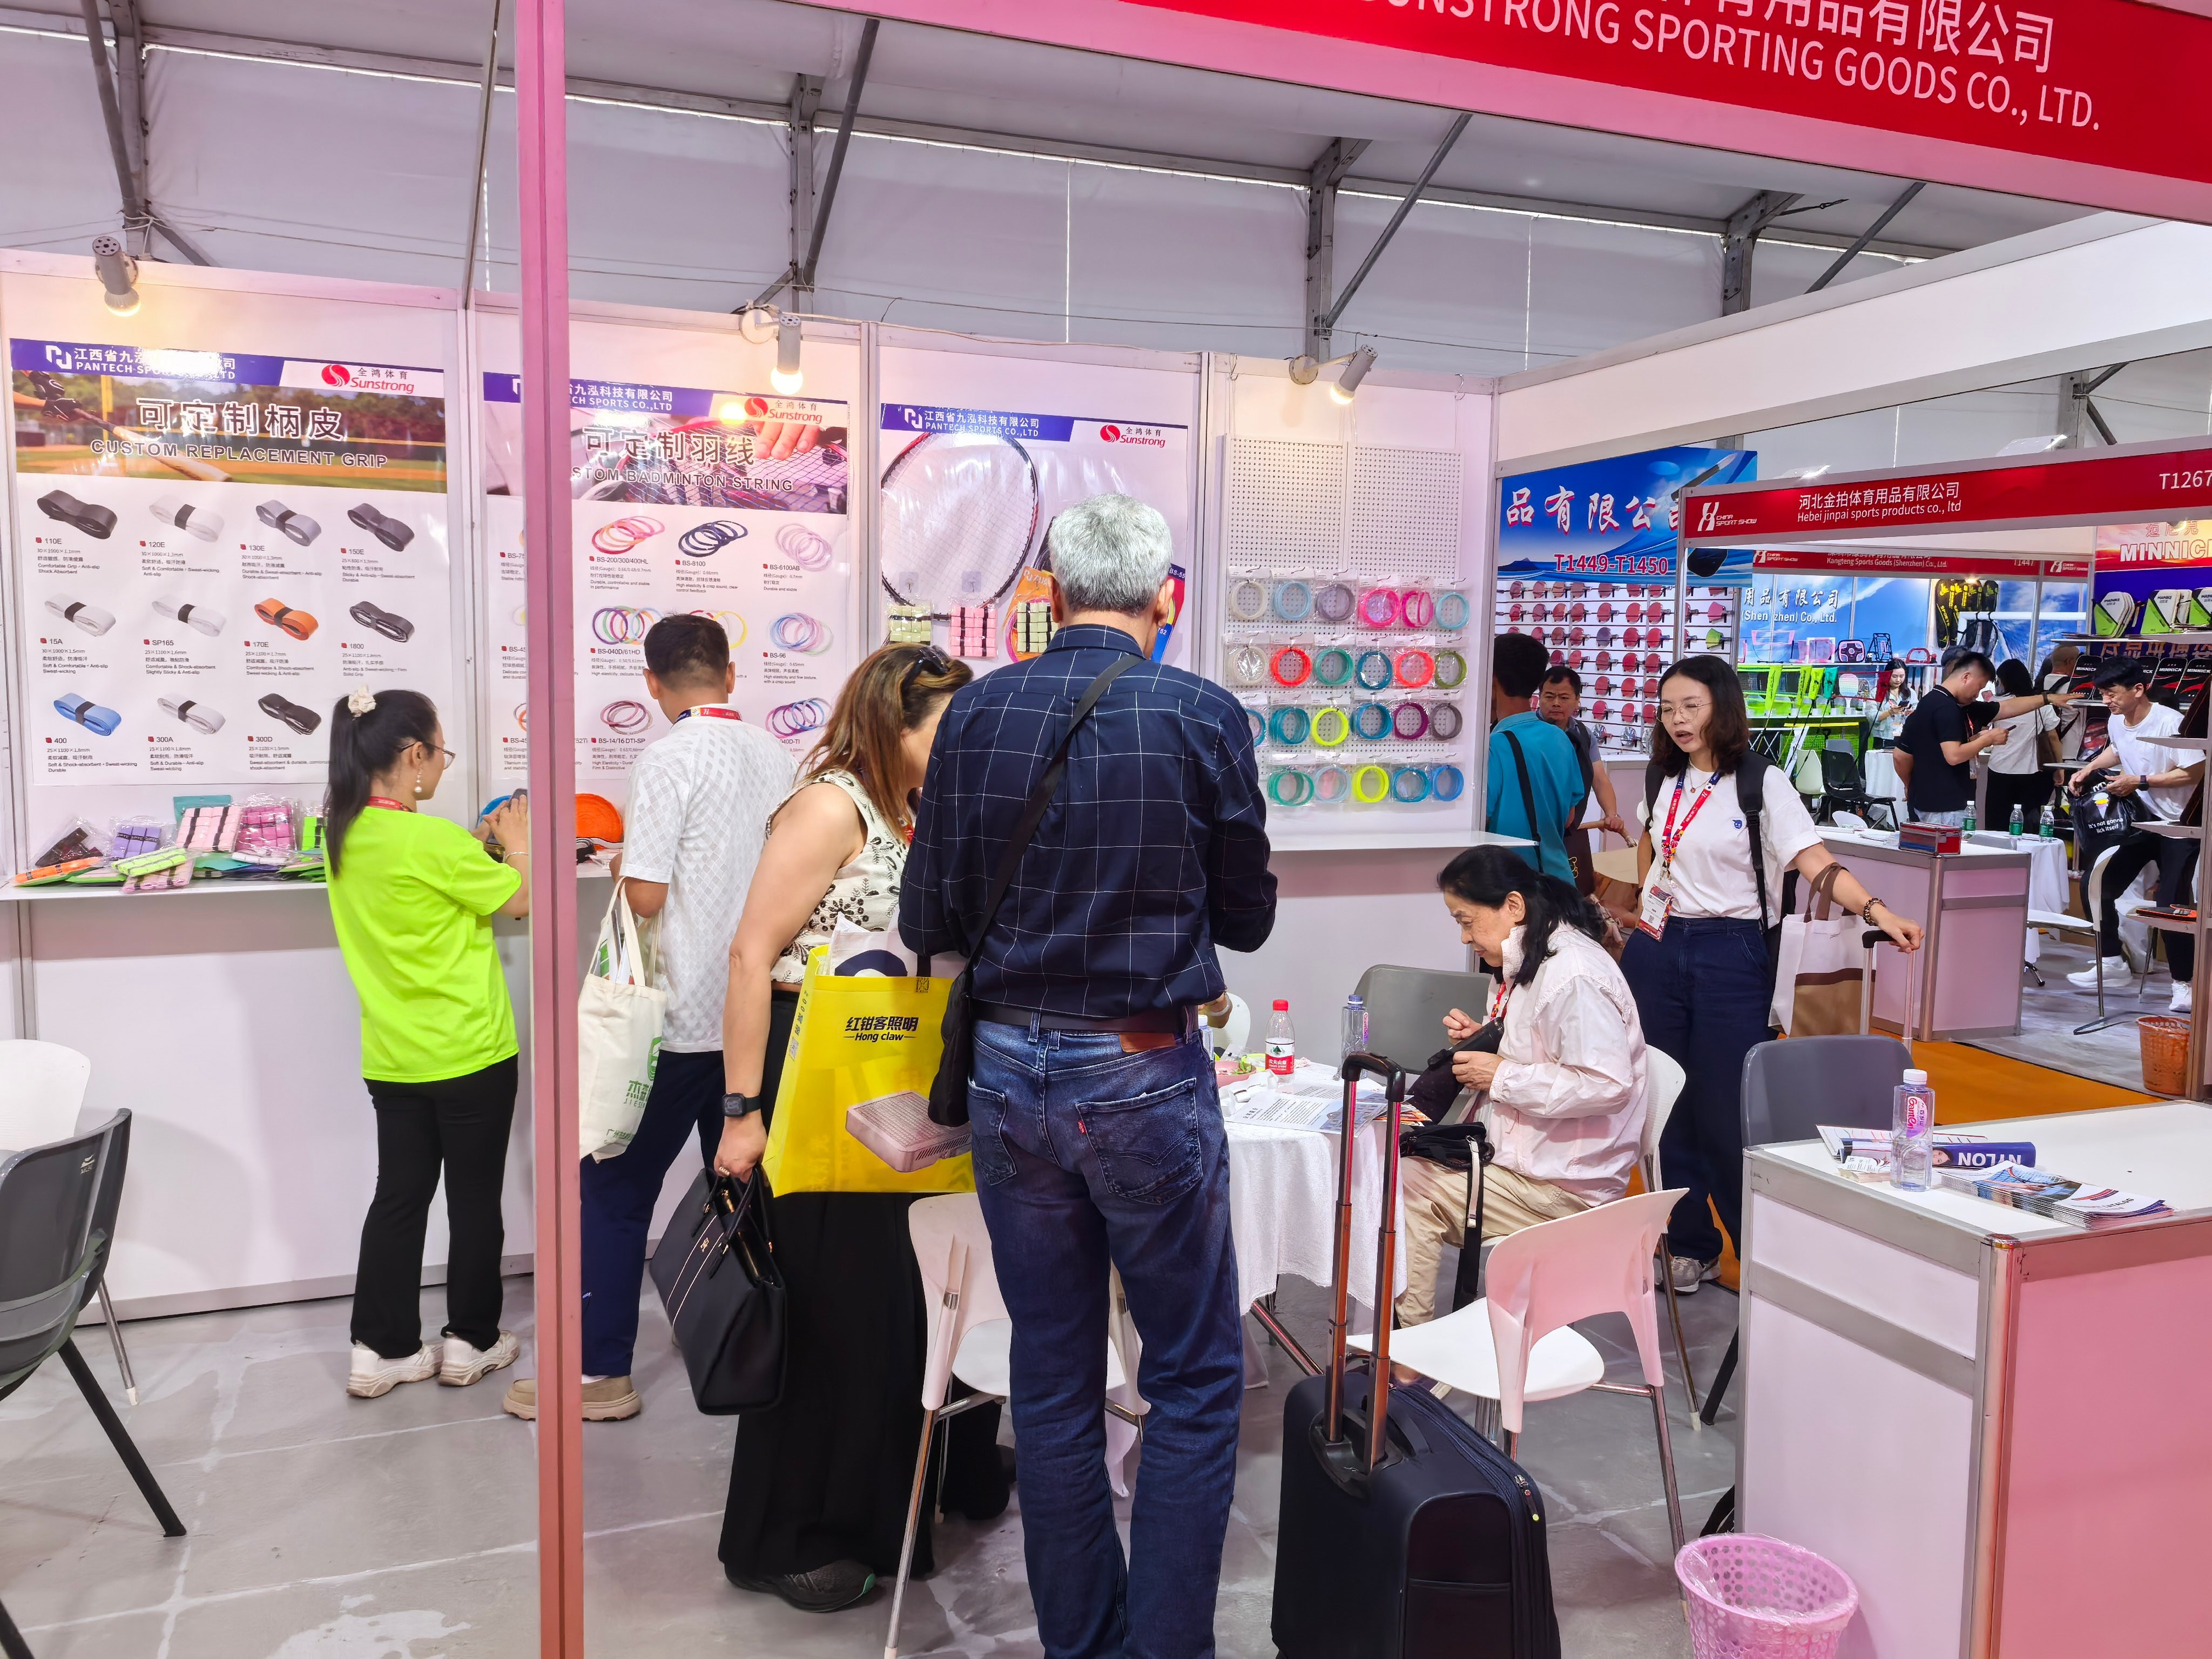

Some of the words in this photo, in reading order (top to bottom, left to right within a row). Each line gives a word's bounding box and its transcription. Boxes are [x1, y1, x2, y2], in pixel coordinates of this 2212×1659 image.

[1378, 0, 1620, 44] STRONG
[1631, 9, 1823, 80] SPORTING
[1836, 47, 1956, 103] GOODS
[1968, 72, 2028, 125] CO.,
[2039, 85, 2099, 130] LTD.
[77, 362, 132, 373] PANTECH
[358, 368, 408, 379] 全鸿体育
[350, 377, 414, 394] Sunstrong
[570, 384, 672, 402] 九泓科技有限公司
[589, 399, 629, 408] SPORTS
[775, 400, 817, 411] 全鸿体育
[136, 397, 343, 441] 可定制柄皮
[768, 409, 822, 424] Sunstrong
[925, 411, 1039, 429] 江西省九泓科技有限公司
[926, 422, 966, 432] PANTECH
[969, 425, 1002, 435] SPORTS
[1005, 428, 1039, 437] CO.,LTD
[1125, 427, 1162, 436] 全鸿体育
[582, 426, 756, 466] 可定制羽线
[1120, 435, 1165, 448] Sunstrong
[90, 439, 179, 458] CUSTOM
[186, 444, 334, 466] REPLACEMENT
[342, 453, 387, 468] GRIP
[570, 467, 619, 482] STOM
[626, 469, 726, 488] BADMINTON
[732, 476, 793, 492] STRING
[2159, 469, 2212, 490] T1267
[1799, 482, 1959, 510] 河北金拍体育用品有限公司
[1798, 509, 1822, 522] Hebei
[1823, 508, 1849, 523] jinpai
[1851, 508, 1879, 520] sports
[1881, 504, 1925, 519] products
[1927, 503, 1945, 515] co.,
[1947, 500, 1961, 512] ltd
[2120, 539, 2212, 562] MINNIC
[1554, 554, 1669, 575] T1449-T1450
[1827, 557, 1854, 566] Kangteng
[1855, 558, 1873, 566] Sports
[1893, 559, 1925, 567] (Shenzhen)
[1744, 588, 1839, 609] 用品有限公司
[1774, 611, 1798, 623] zhen)
[1800, 611, 1818, 623] Co.,
[1820, 612, 1837, 623] Ltd.
[845, 1016, 919, 1032] 红钳客照明
[854, 1033, 878, 1042] Hong
[881, 1033, 904, 1041] claw
